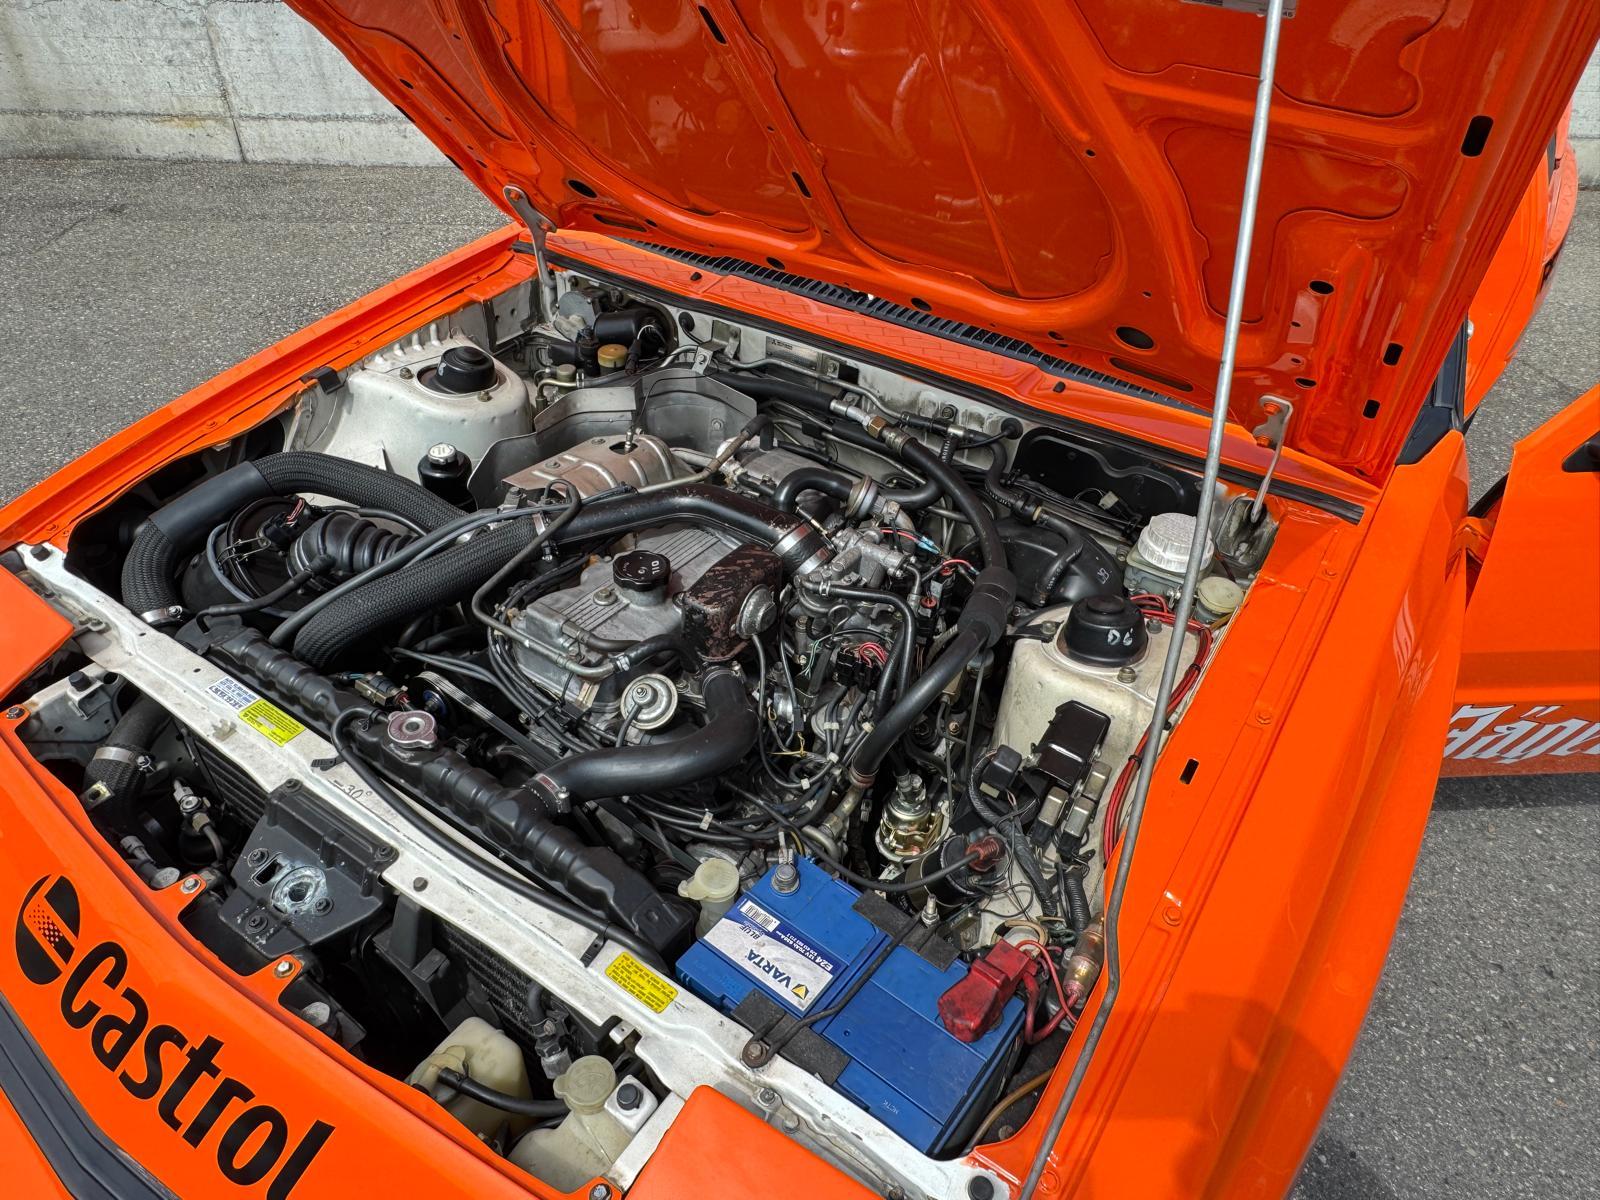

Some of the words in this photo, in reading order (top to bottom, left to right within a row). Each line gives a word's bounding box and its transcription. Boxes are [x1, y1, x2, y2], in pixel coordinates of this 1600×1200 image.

[651, 560, 661, 575] OIL
[1444, 703, 1600, 765] Jäge
[739, 924, 761, 940] BLUE
[804, 951, 815, 961] 12V
[814, 955, 834, 972] E24
[747, 948, 792, 989] VARTA
[60, 940, 337, 1200] Castrol
